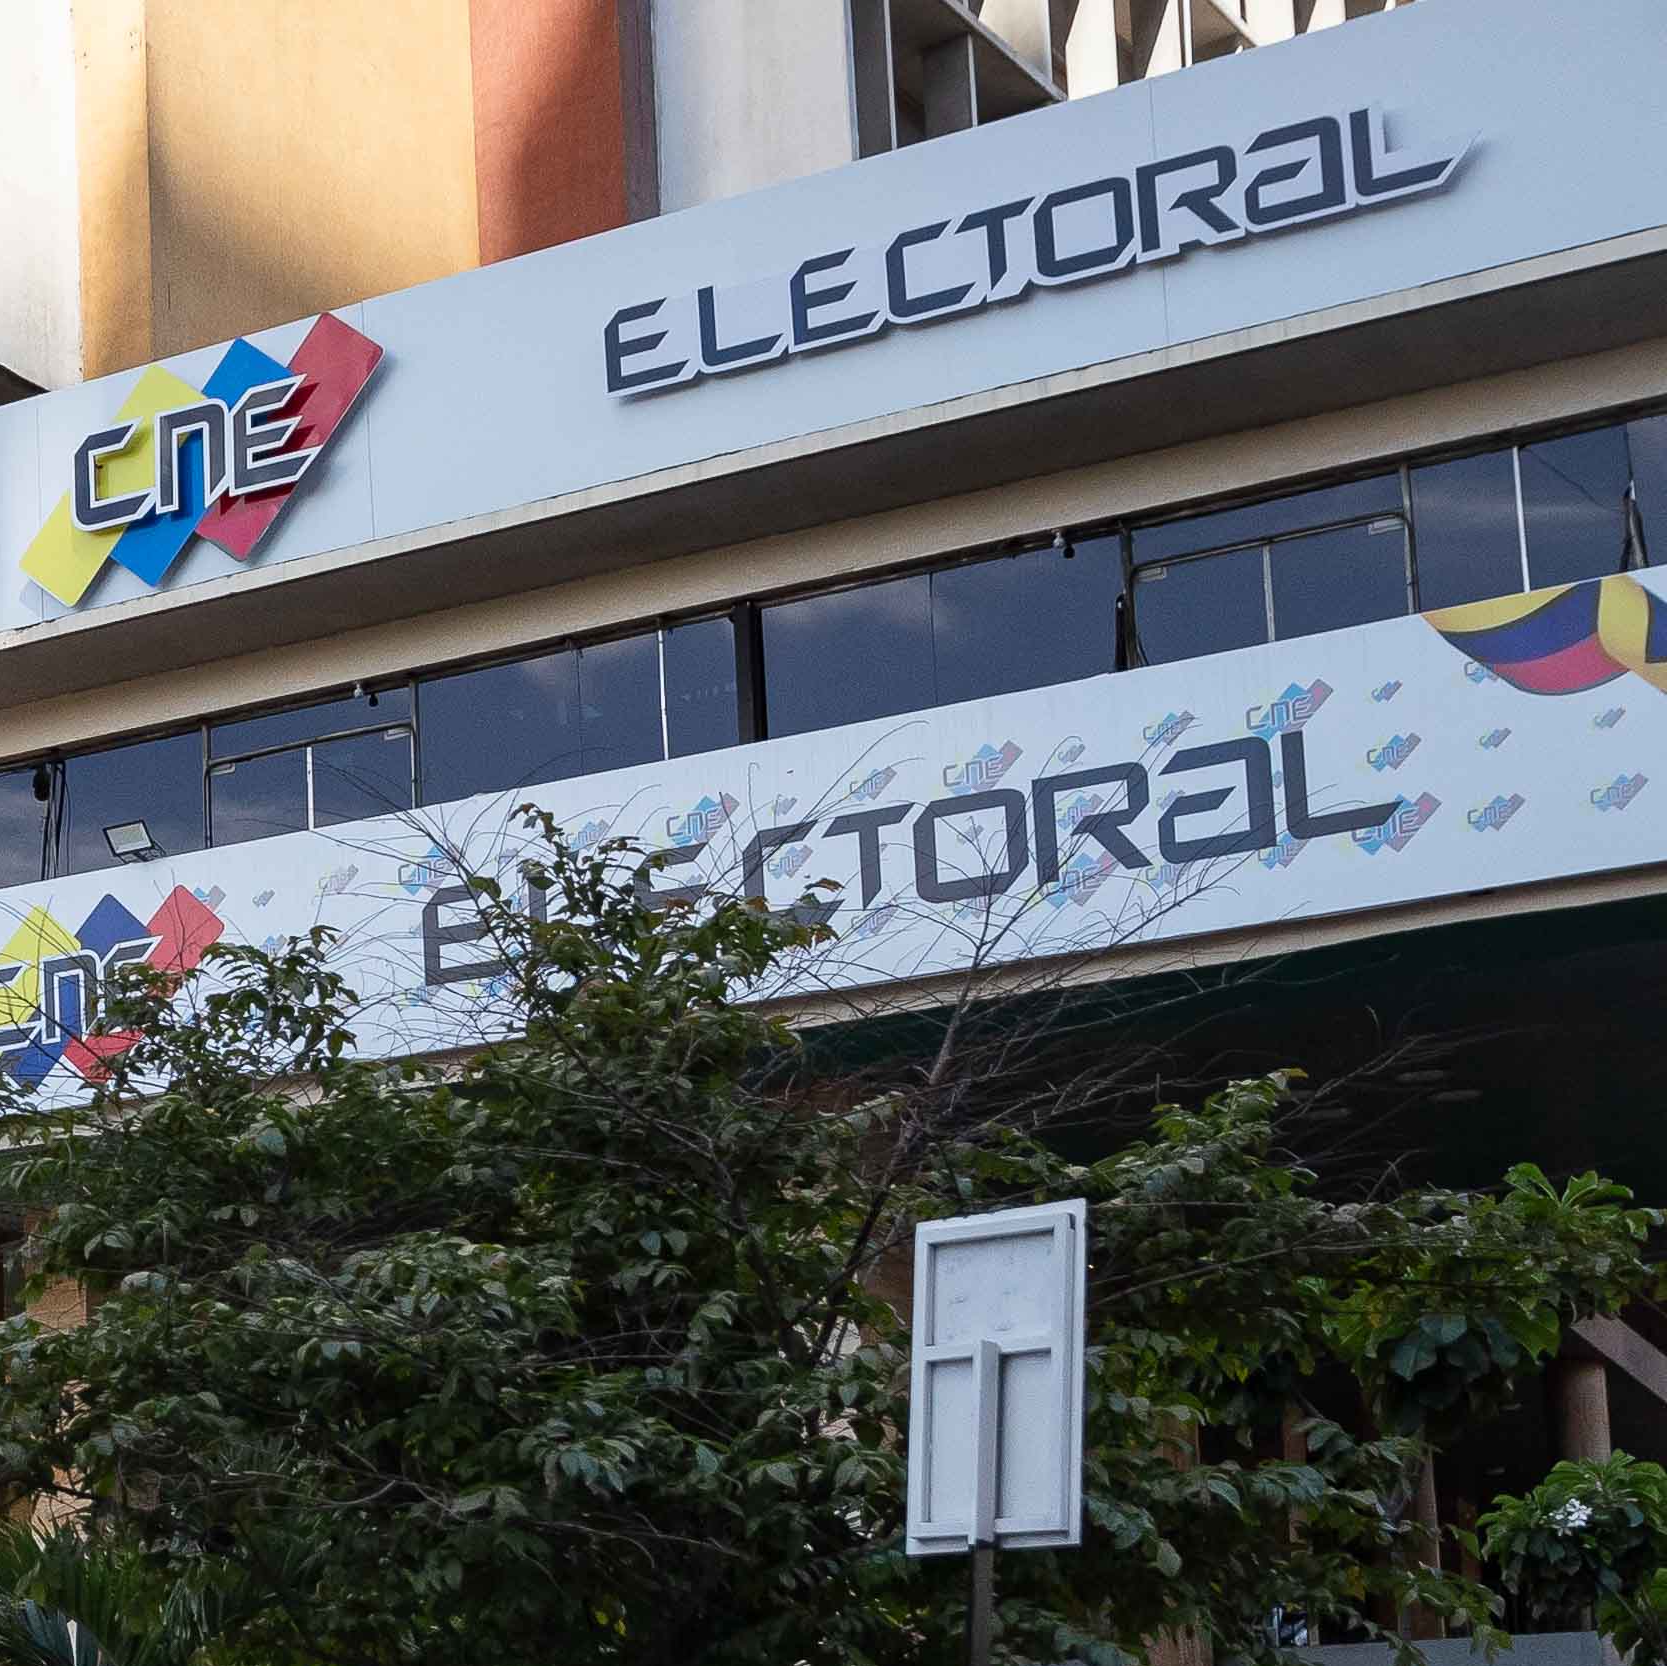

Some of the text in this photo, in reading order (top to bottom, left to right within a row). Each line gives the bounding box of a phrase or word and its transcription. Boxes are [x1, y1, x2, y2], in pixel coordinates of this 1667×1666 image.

[73, 373, 321, 532] CNE
[605, 106, 1457, 396] ELECTORAL
[1245, 696, 1312, 730] CNE
[943, 759, 1004, 787] CNE
[667, 806, 719, 839] CNE
